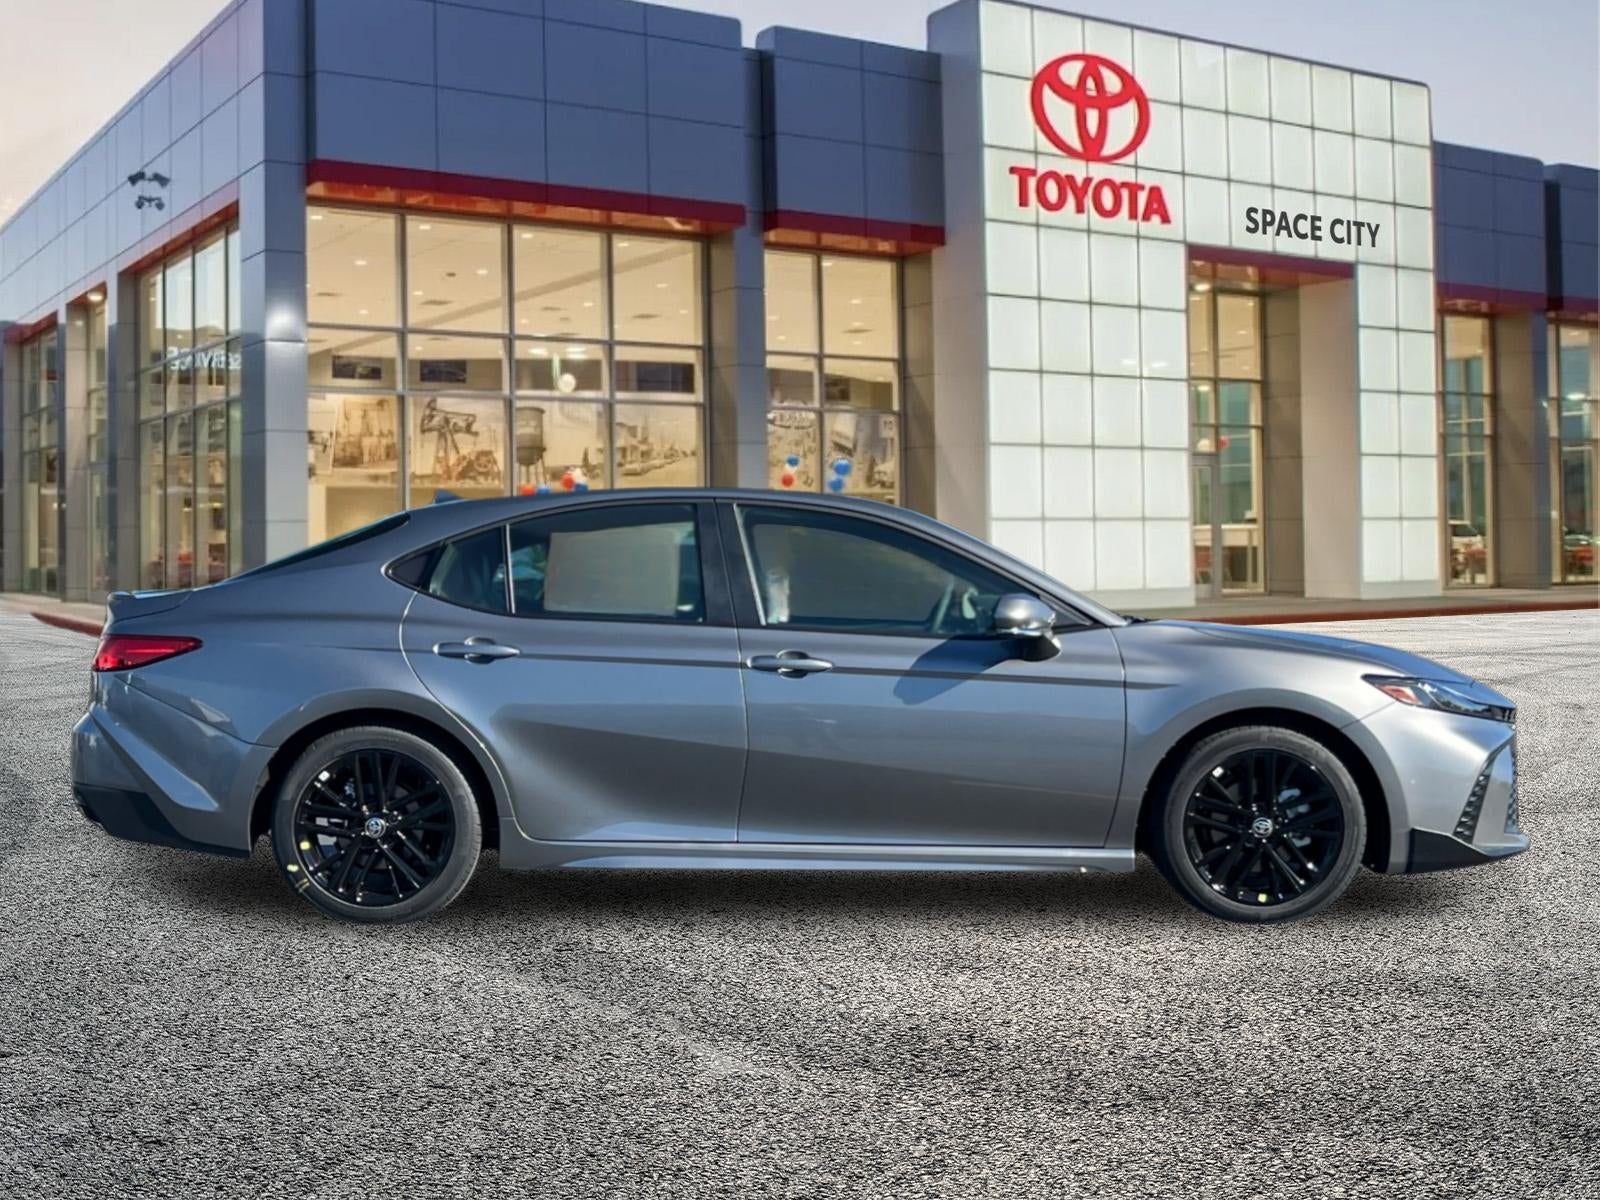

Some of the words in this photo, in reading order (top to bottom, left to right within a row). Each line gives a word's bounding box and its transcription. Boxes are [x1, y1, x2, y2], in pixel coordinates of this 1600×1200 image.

[1009, 166, 1171, 224] TOYOTA
[1245, 206, 1323, 242] SPACE
[1329, 217, 1381, 248] CITY
